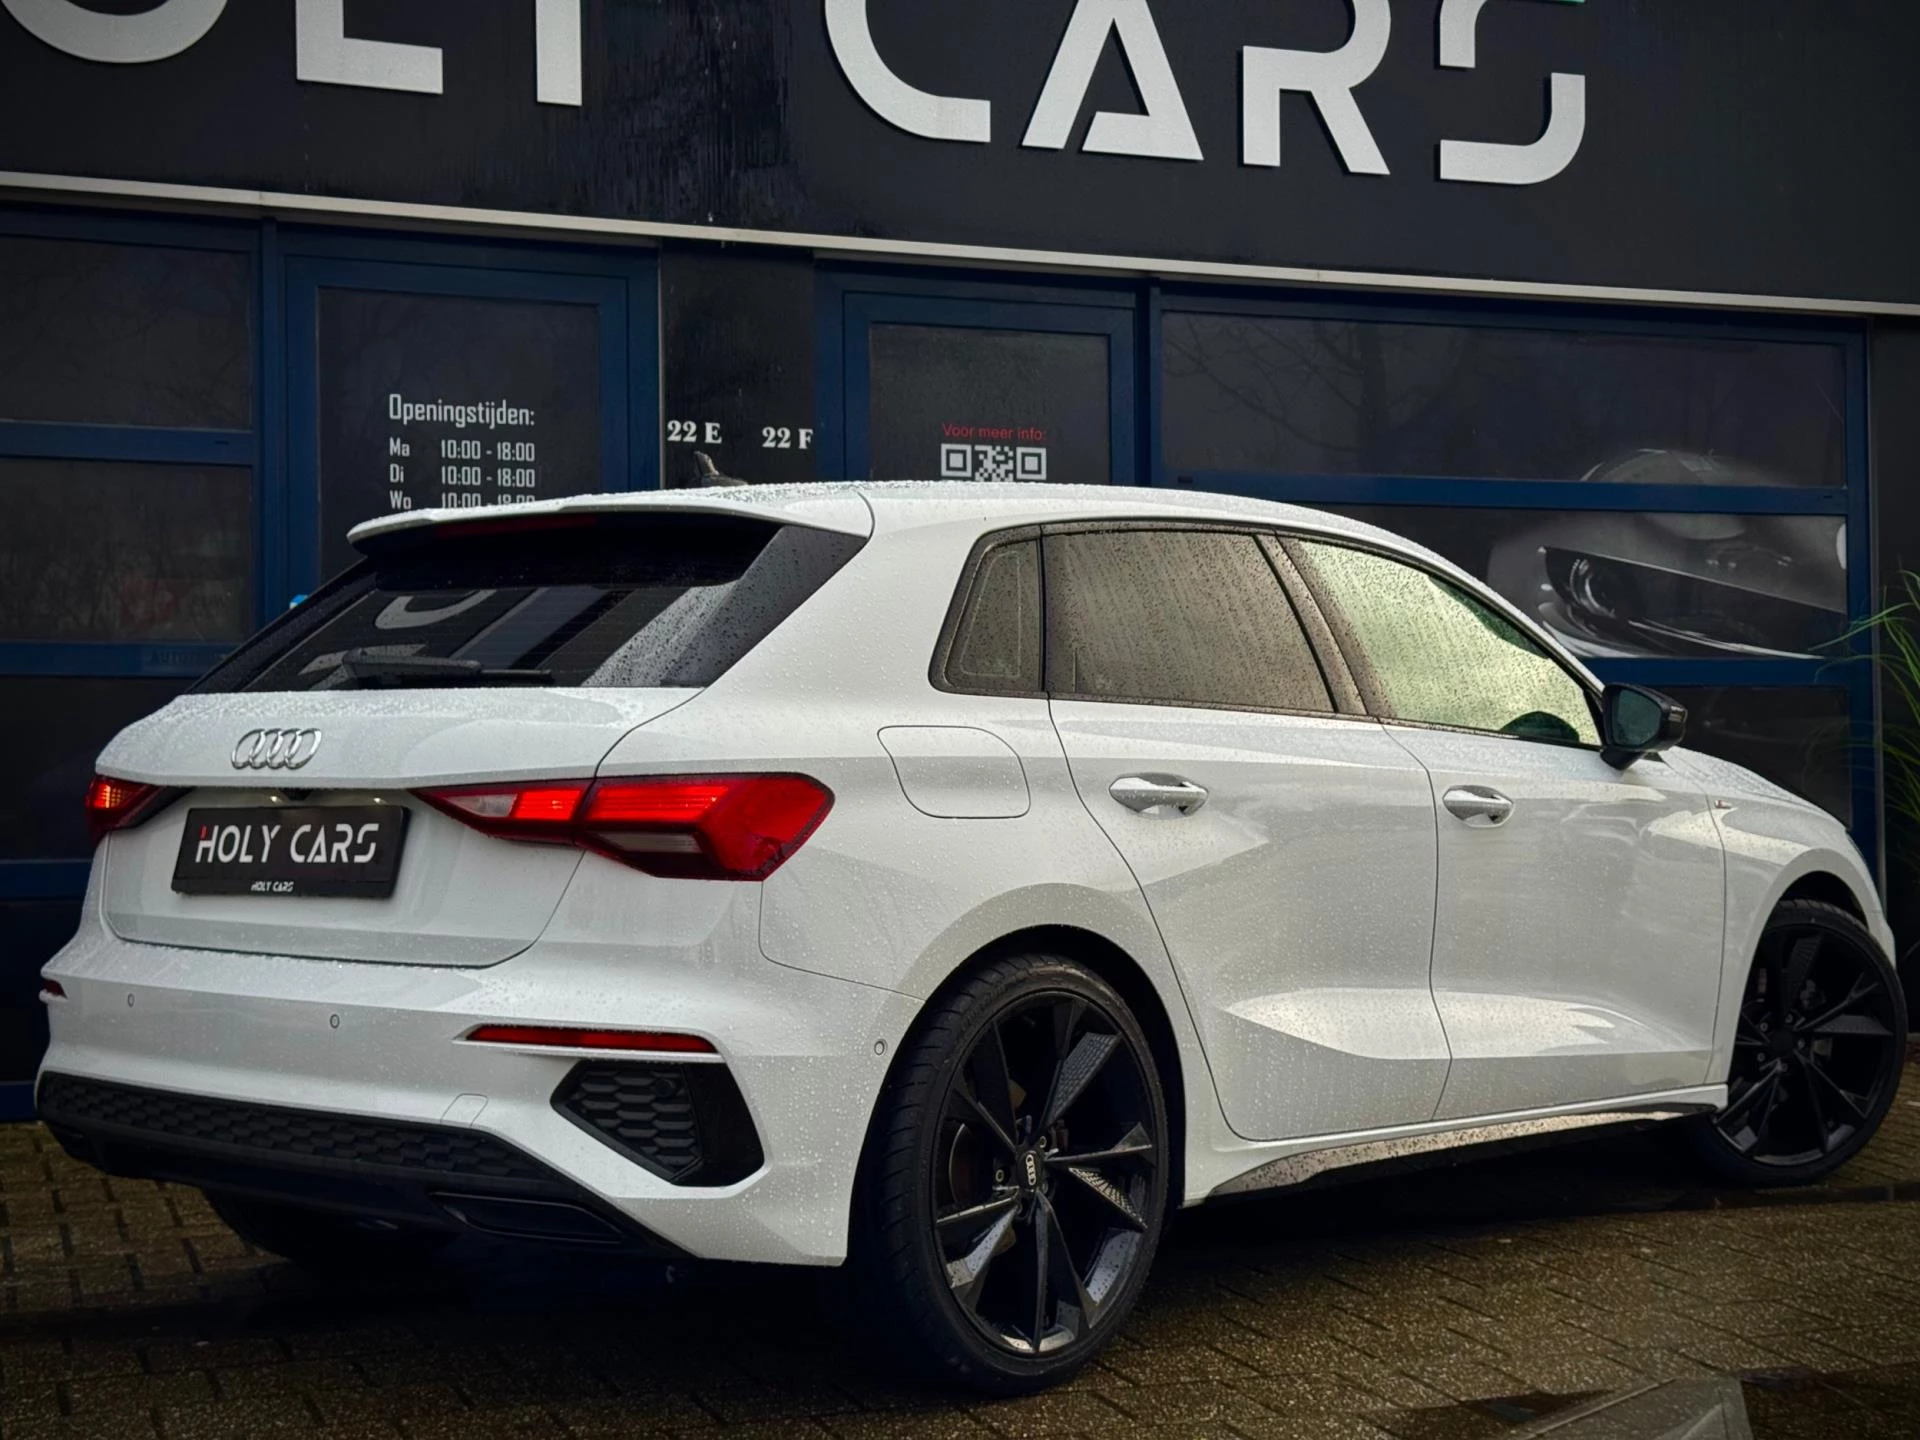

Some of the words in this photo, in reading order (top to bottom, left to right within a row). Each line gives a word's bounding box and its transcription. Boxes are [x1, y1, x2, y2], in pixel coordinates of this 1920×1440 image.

[825, 0, 1586, 185] CARS
[388, 393, 535, 430] Openingstijden:
[667, 420, 697, 443] 22
[704, 422, 723, 444] E
[762, 426, 791, 449] 22
[798, 428, 814, 449] F
[942, 423, 975, 438] Voor
[978, 427, 1014, 439] meer
[1017, 428, 1046, 441] info:
[389, 437, 411, 457] Ma
[441, 440, 481, 460] 10:00
[497, 442, 536, 462] 18:00
[389, 463, 405, 483] Di
[441, 466, 482, 486] 10:00
[498, 468, 536, 488] 18:00
[389, 490, 412, 510] Wo
[441, 493, 482, 509] 10:00
[195, 824, 281, 863] HOLY
[290, 823, 379, 863] CARS
